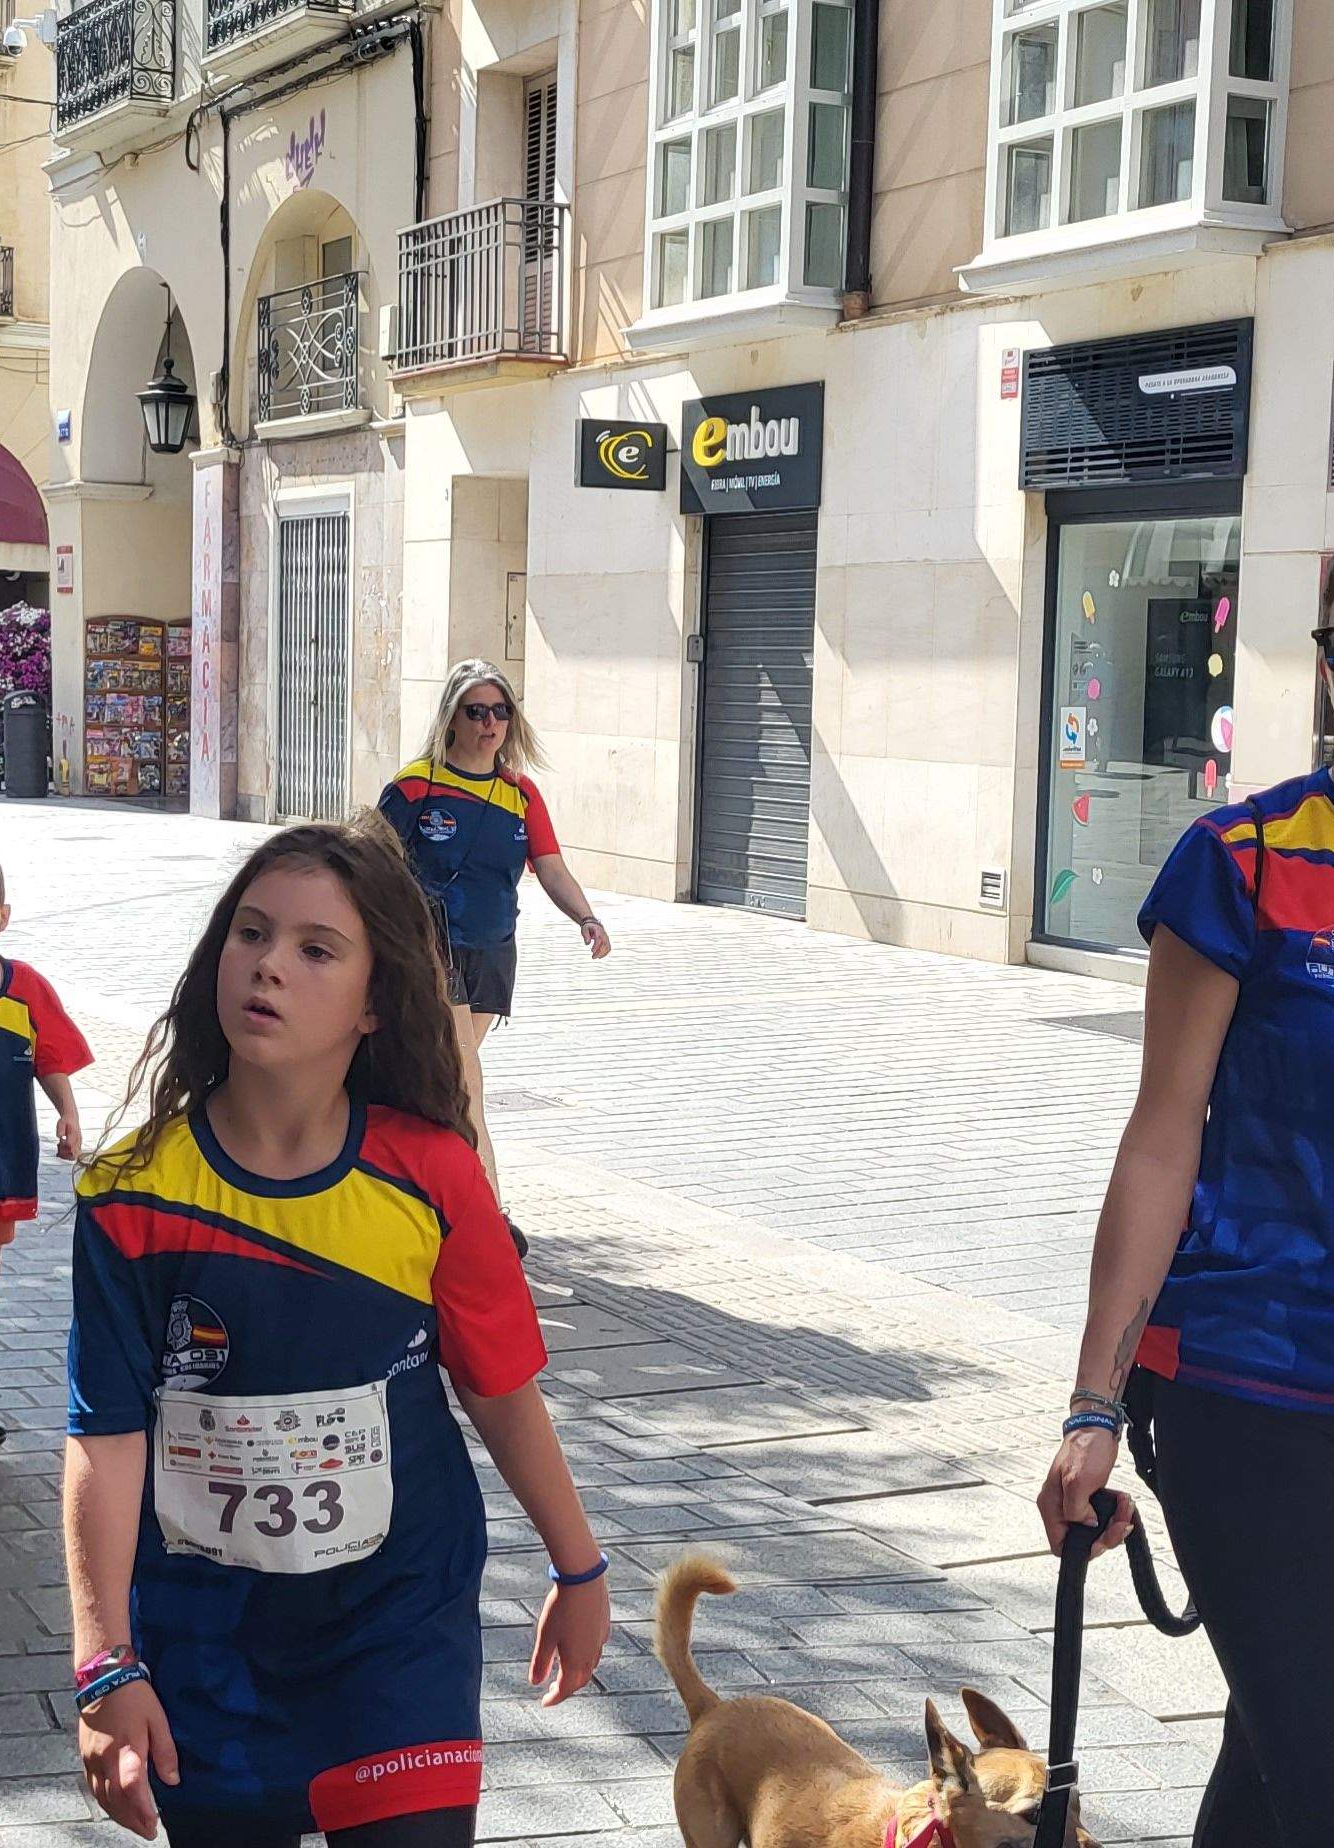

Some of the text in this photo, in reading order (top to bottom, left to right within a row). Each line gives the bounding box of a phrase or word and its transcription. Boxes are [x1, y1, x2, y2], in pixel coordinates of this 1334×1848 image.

[692, 405, 799, 467] embou
[199, 480, 213, 762] FARMACIA
[208, 1480, 345, 1538] 733
